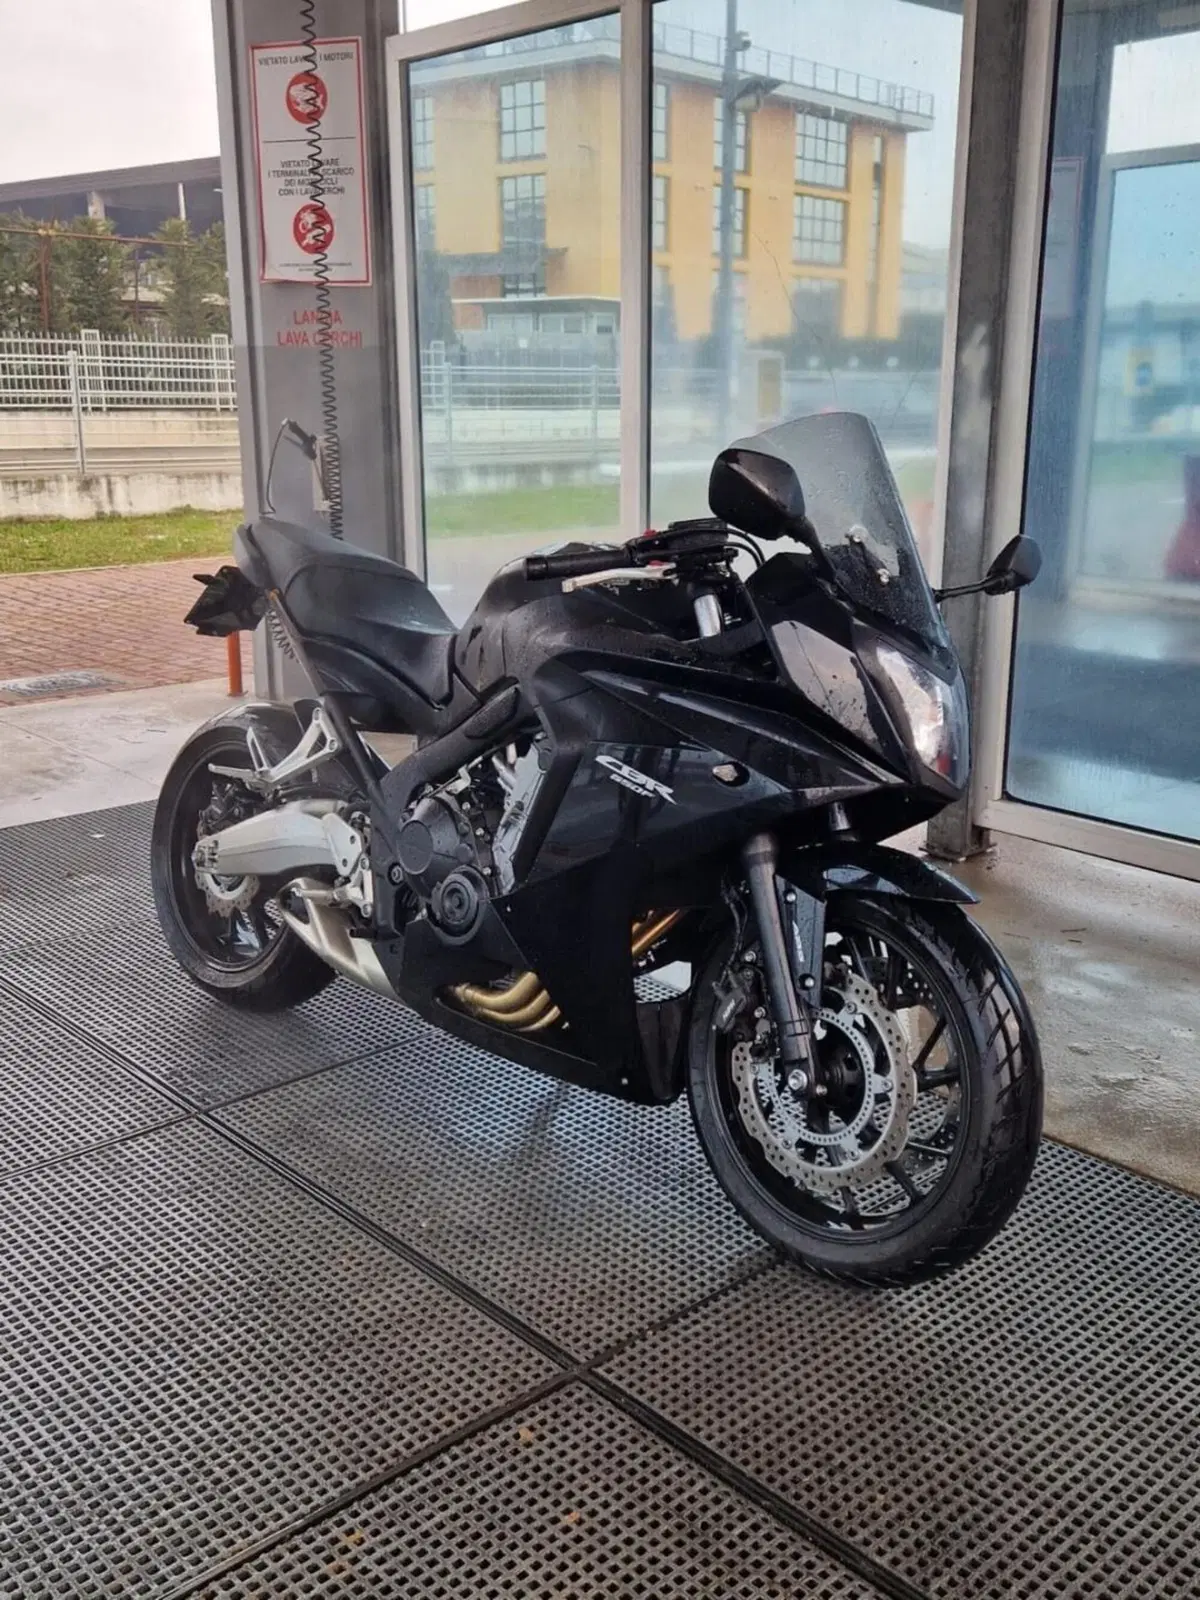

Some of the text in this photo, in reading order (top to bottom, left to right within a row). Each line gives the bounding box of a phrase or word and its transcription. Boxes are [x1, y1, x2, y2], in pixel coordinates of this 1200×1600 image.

[258, 55, 288, 66] VIETATO
[290, 54, 316, 64] LAV
[323, 52, 354, 61] MOTORI
[280, 159, 310, 169] VIETATO
[321, 167, 355, 176] SCARICO
[284, 177, 338, 188] DEI MOTCICLI
[278, 187, 294, 196] CON
[277, 331, 310, 346] LAVA
[595, 755, 678, 805] CBR
